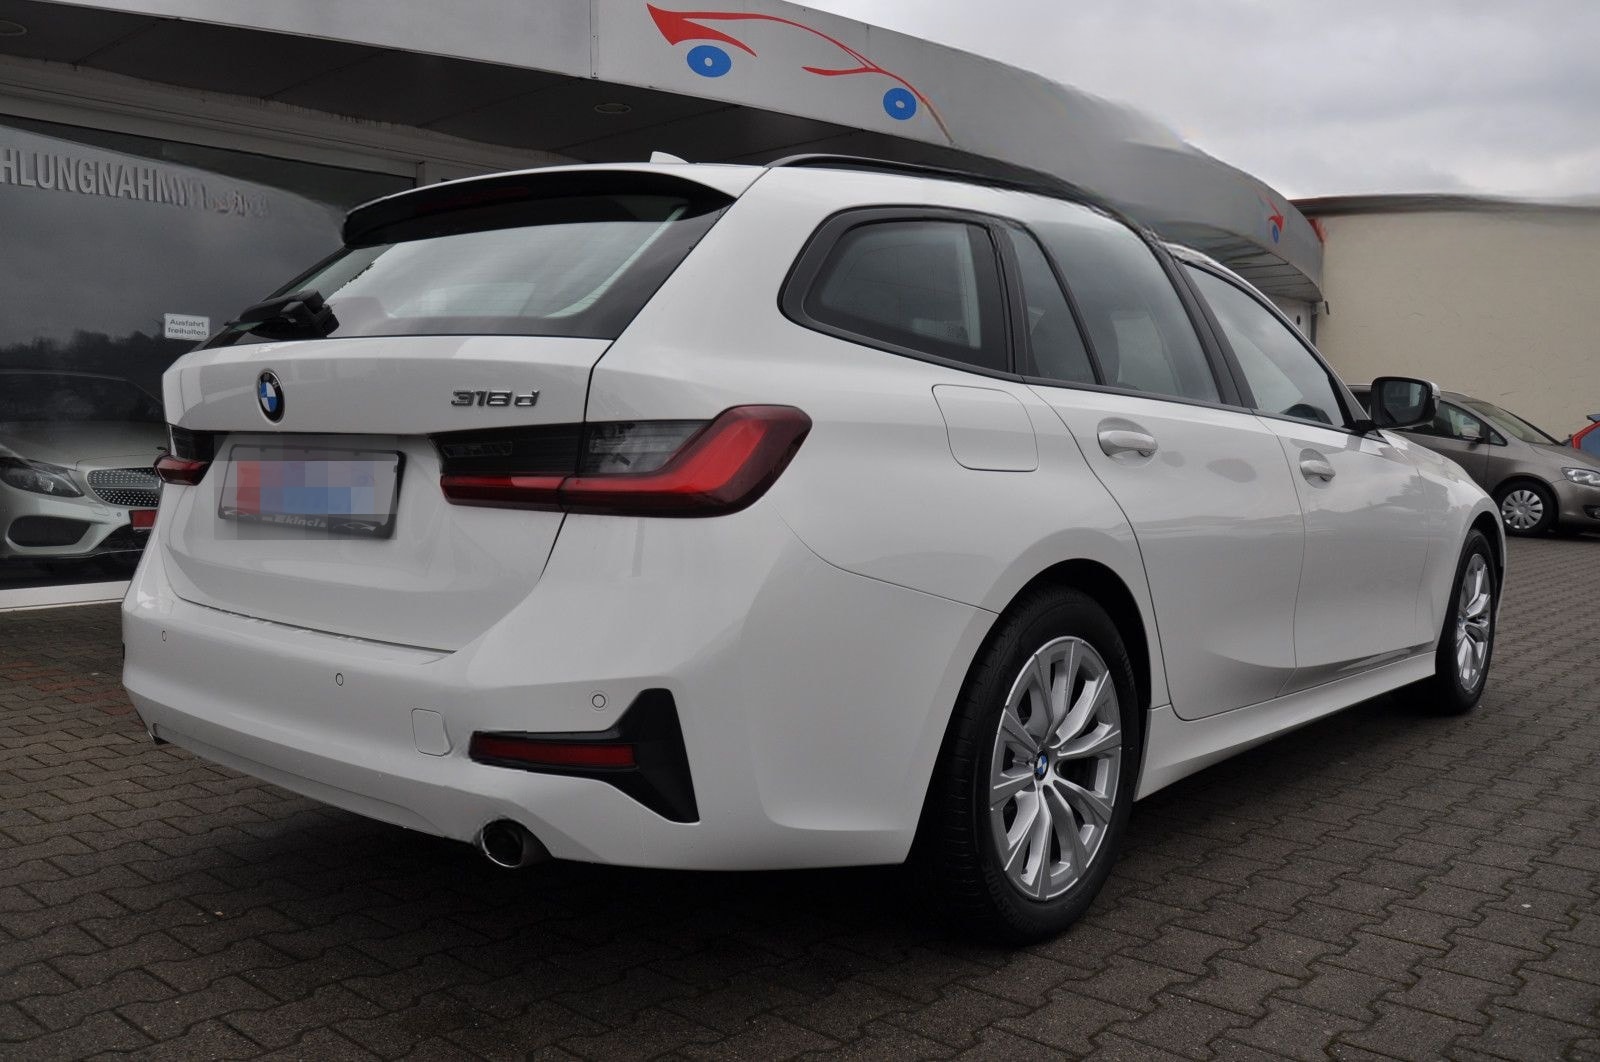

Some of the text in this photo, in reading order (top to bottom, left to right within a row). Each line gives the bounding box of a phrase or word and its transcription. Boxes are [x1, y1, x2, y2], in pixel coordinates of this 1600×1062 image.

[169, 319, 205, 328] Ausfahrt
[167, 326, 207, 336] freihalten
[450, 390, 540, 407] 318d
